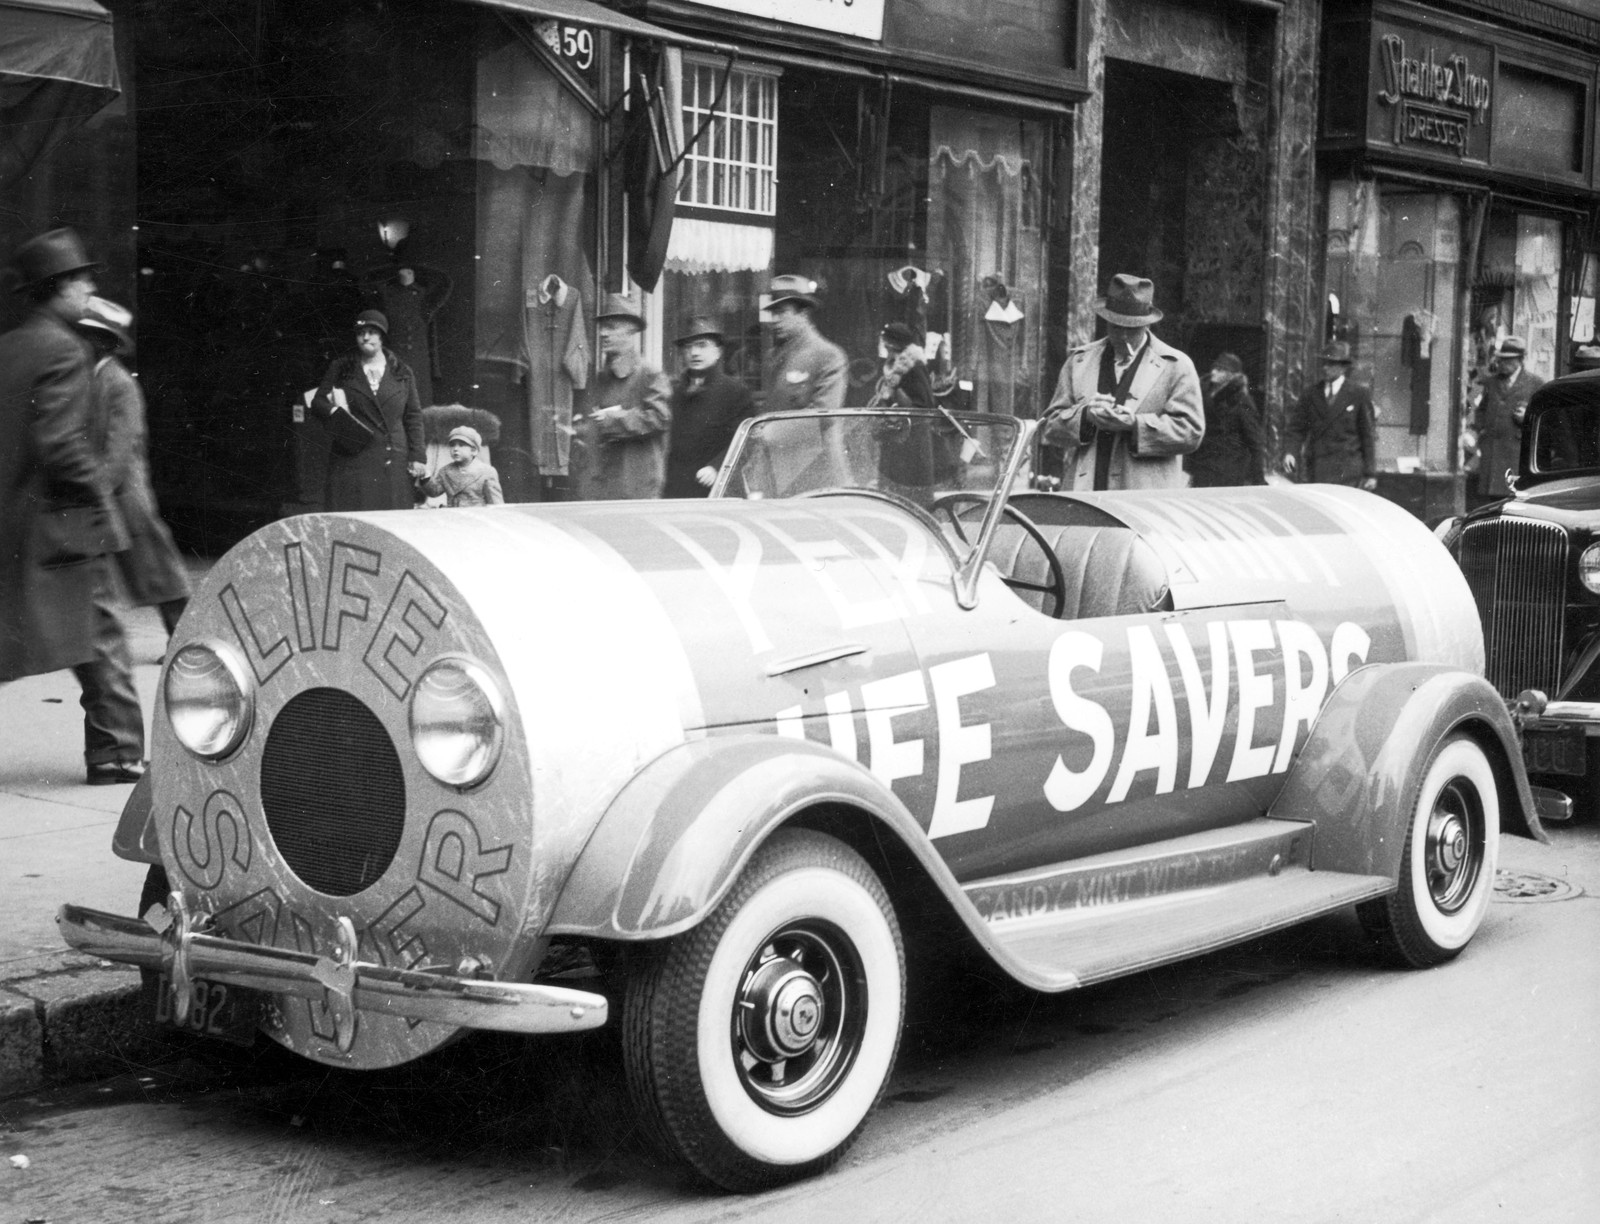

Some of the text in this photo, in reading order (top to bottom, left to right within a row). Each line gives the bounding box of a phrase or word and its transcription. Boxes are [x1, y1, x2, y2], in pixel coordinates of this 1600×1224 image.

[563, 26, 594, 70] 59
[1449, 53, 1490, 124] Shop
[1408, 114, 1466, 147] DRESSES
[218, 540, 448, 702] LIFE
[776, 652, 998, 840] FE
[1076, 867, 1138, 908] MINT
